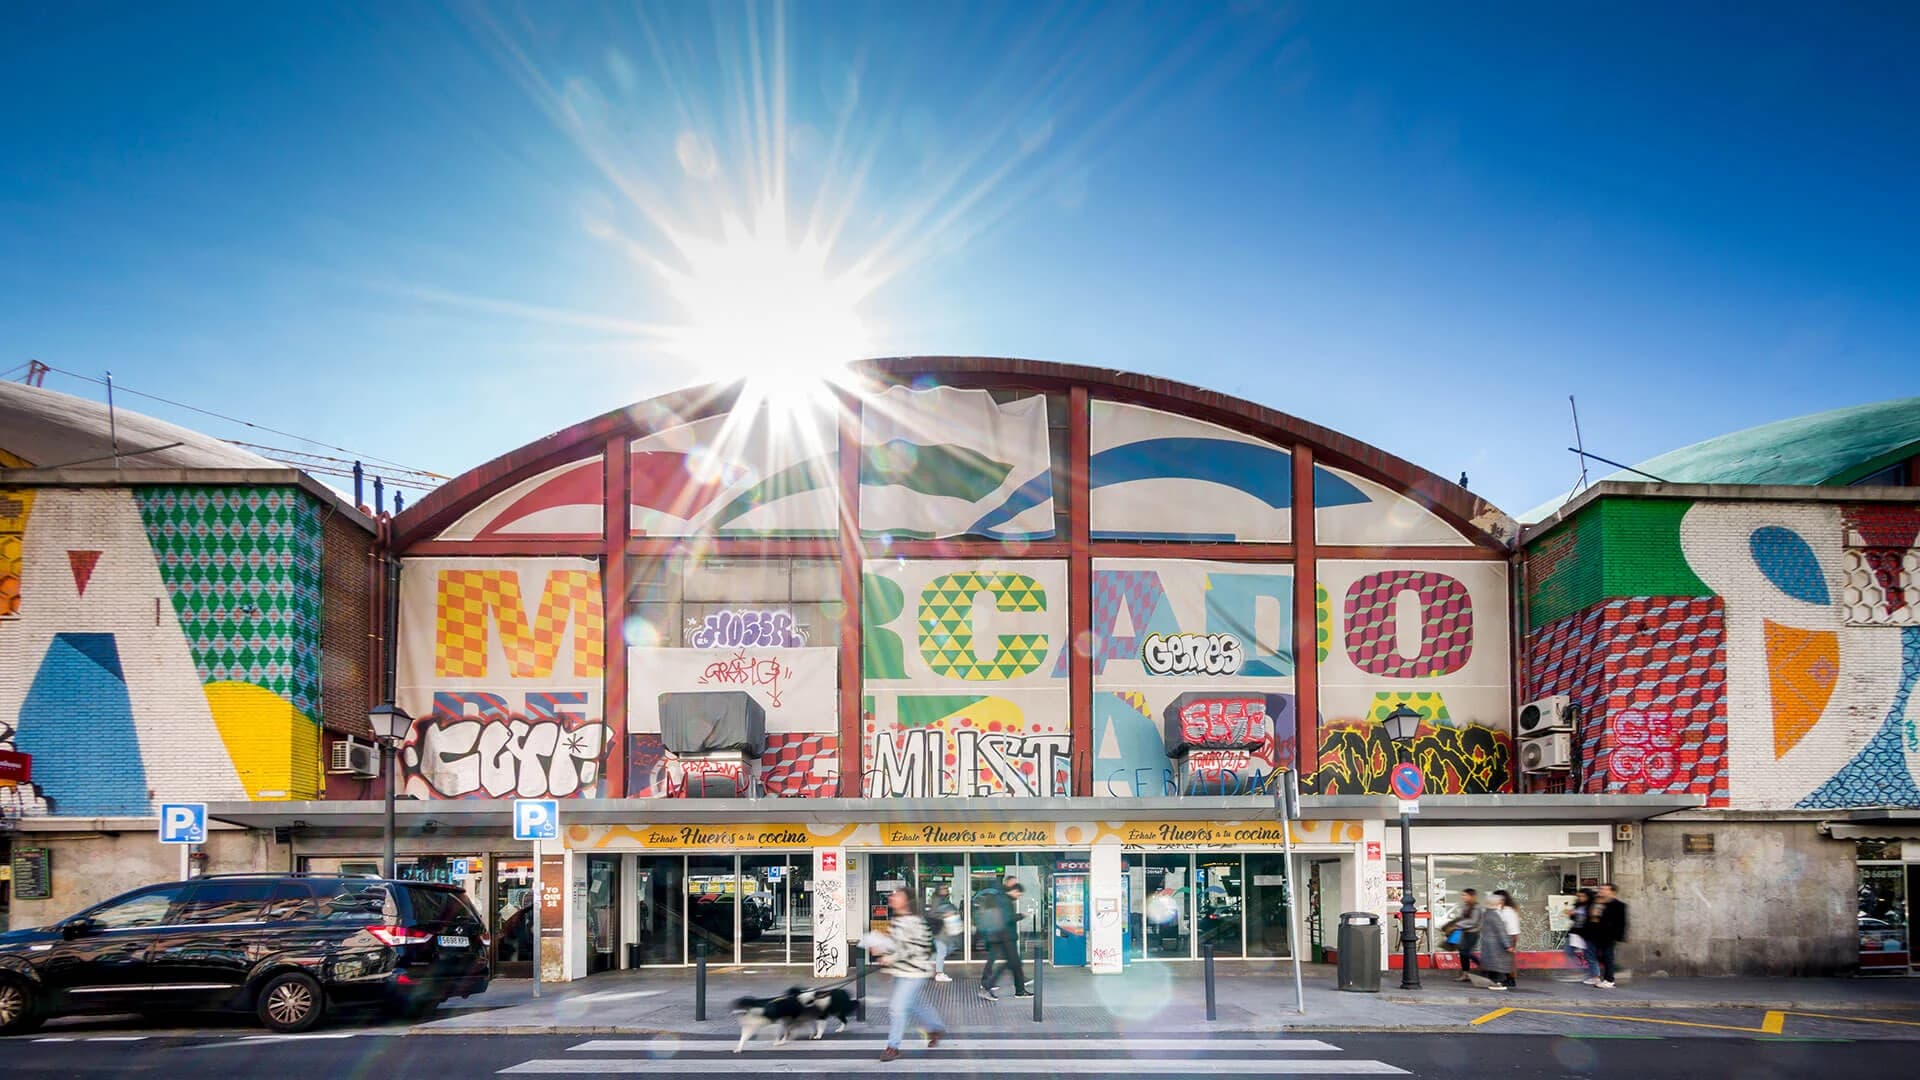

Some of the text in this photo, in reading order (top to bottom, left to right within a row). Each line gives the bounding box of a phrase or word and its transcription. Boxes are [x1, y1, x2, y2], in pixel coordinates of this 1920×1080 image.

[1106, 767, 1268, 799] CEBADA
[166, 807, 195, 839] P
[520, 803, 548, 836] P
[680, 826, 737, 845] Huevos
[758, 829, 809, 844] cocina
[922, 825, 977, 843] Huevos
[999, 828, 1049, 842] cocina
[1158, 823, 1213, 841] Huevos
[1234, 826, 1281, 841] cocina
[543, 893, 561, 901] QUE
